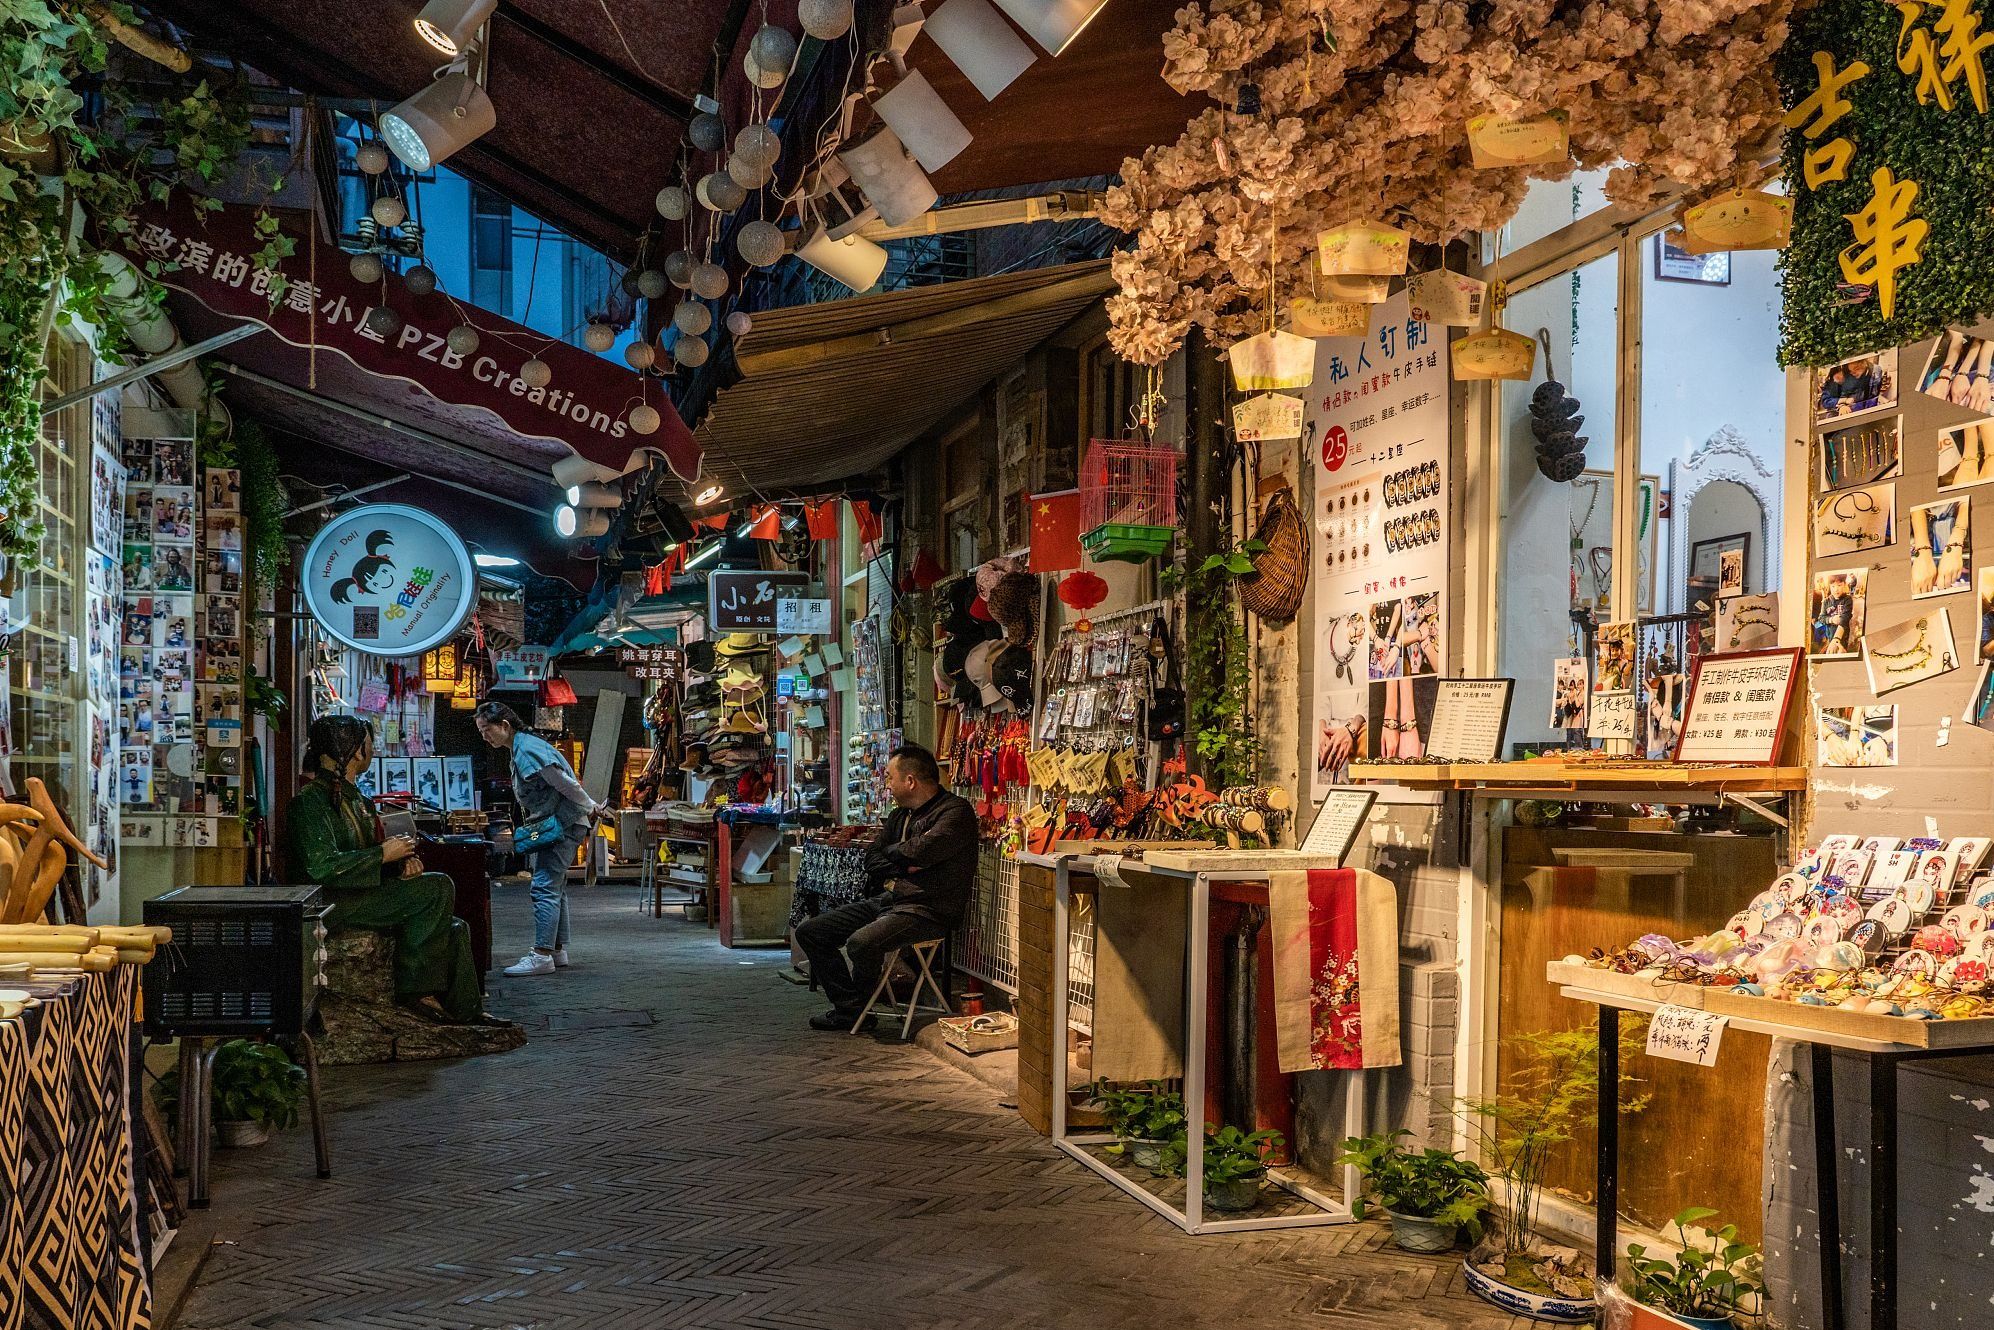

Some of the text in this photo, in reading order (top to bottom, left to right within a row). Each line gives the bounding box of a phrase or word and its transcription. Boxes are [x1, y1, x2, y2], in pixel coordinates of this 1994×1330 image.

[1781, 51, 1869, 191] 吉
[1839, 167, 1928, 320] 串
[127, 214, 386, 345] 政滨的创意小屋
[1330, 317, 1427, 385] 私人订制
[397, 324, 628, 438] PZB Creations
[1325, 432, 1346, 464] 25
[1370, 443, 1404, 465] 十二星座
[322, 530, 359, 578] Honey Doll
[401, 572, 451, 637] Manual Originality
[784, 601, 822, 613] 招租
[621, 649, 677, 662] 姚哥穿耳
[634, 667, 676, 679] 改耳夹
[1702, 688, 1777, 705] 情侣款 & 闺蜜款
